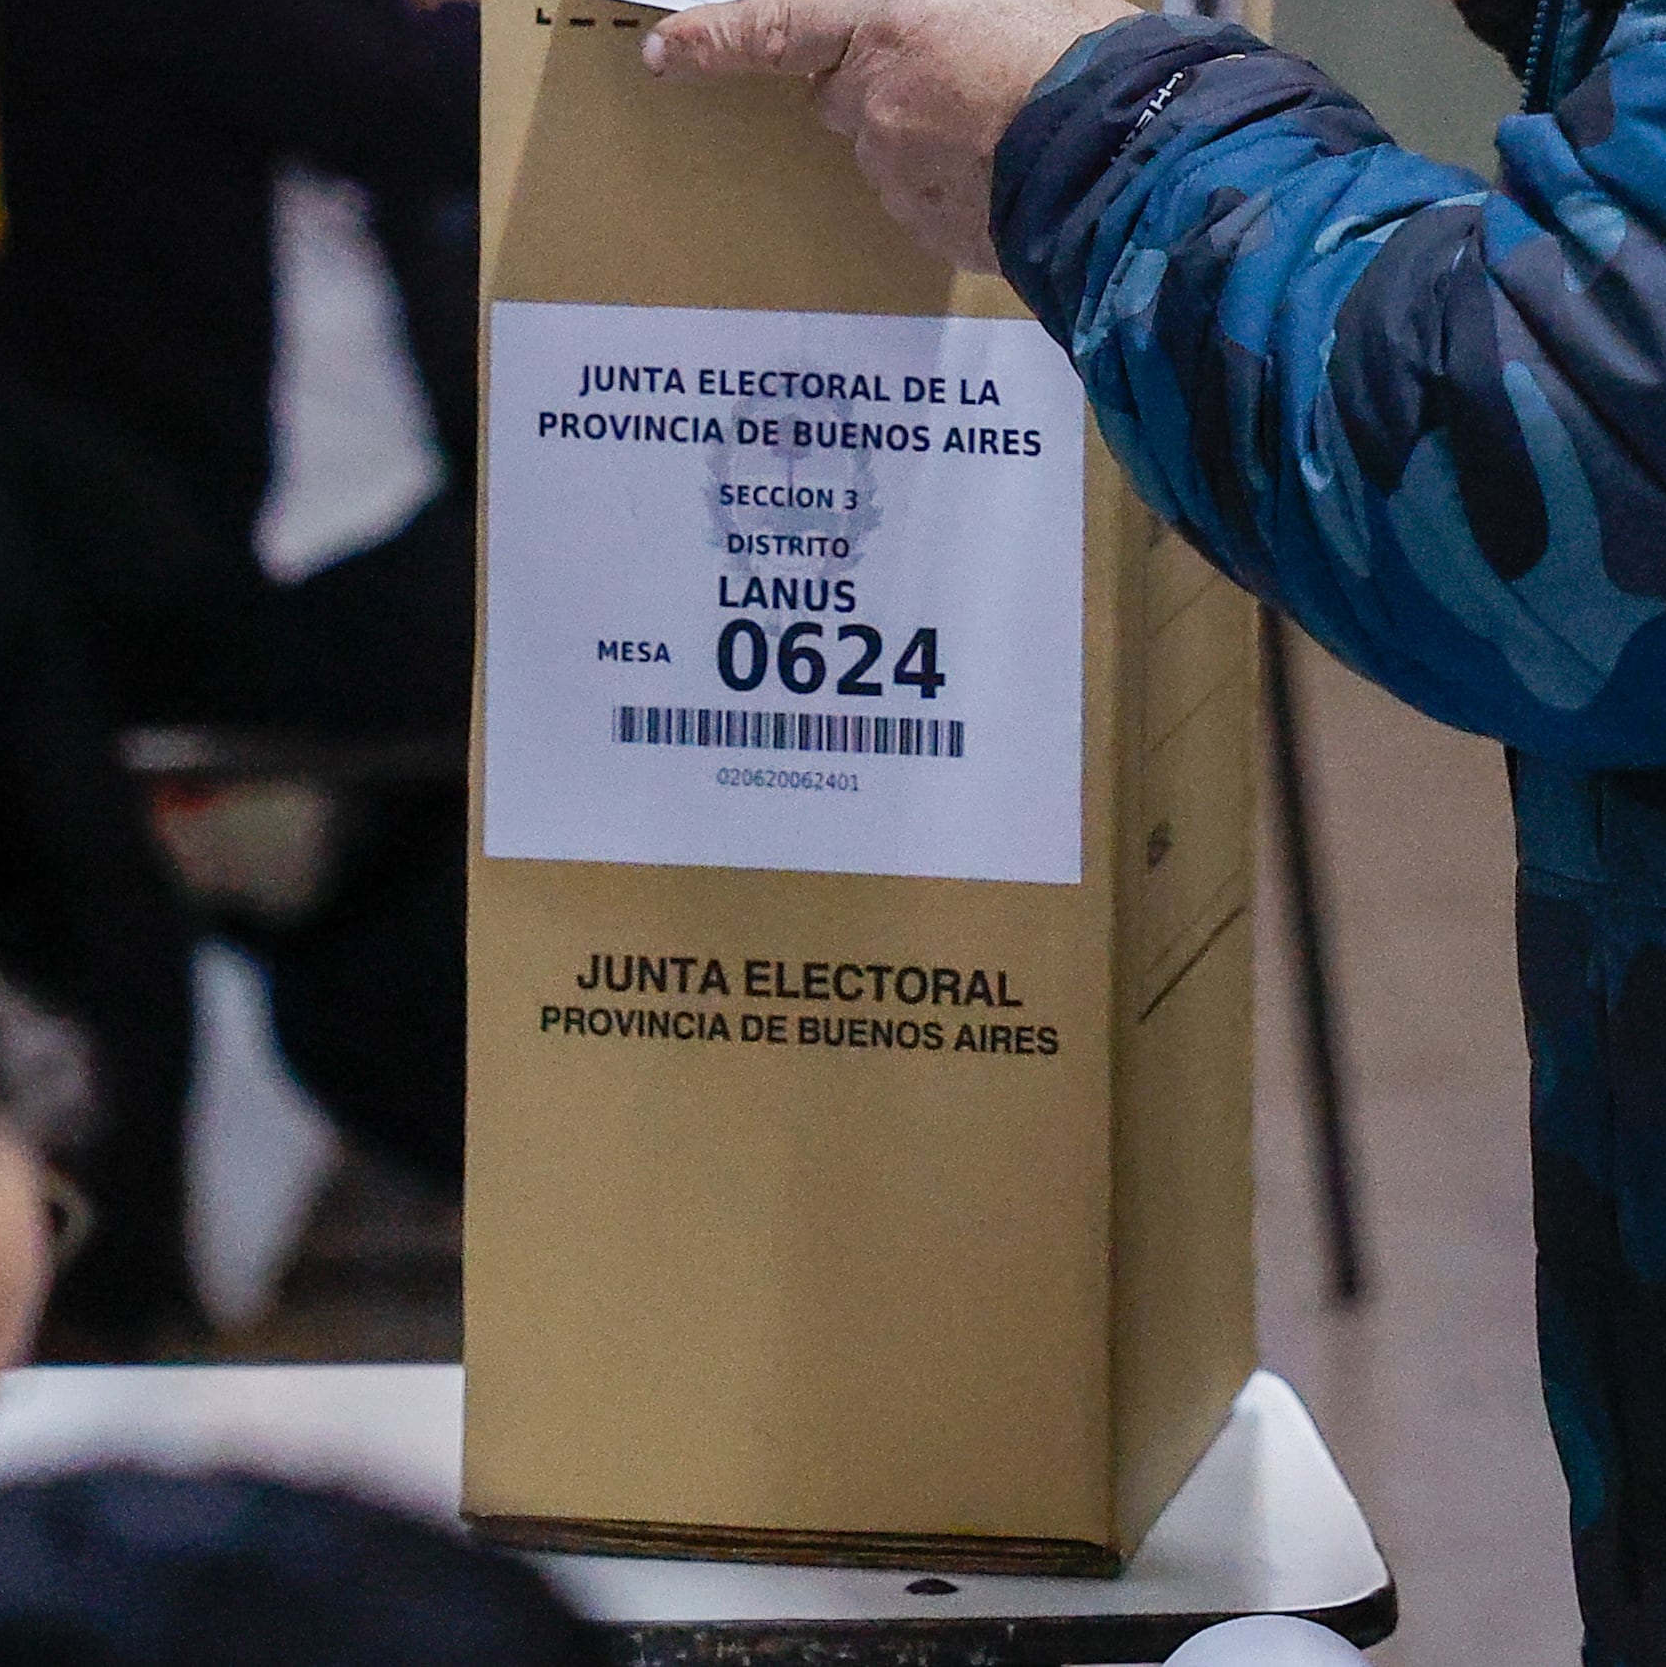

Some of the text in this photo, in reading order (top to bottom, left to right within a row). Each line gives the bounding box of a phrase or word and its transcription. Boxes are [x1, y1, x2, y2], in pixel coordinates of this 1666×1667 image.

[578, 365, 1001, 406] JUNTA ELECTORAL DE LA
[538, 411, 1042, 457] PROVINCIA DE BUENOS AIRES
[719, 484, 859, 511] SECCION 3
[727, 533, 850, 559] DISTRITO
[718, 576, 857, 613] LANUS
[597, 617, 947, 699] MESA 0624
[715, 766, 860, 792] 020620062401
[576, 954, 1024, 1008] JUNTA ELECTORAL
[539, 1005, 1060, 1056] PROVINCIA DE BUENOS AIRES
